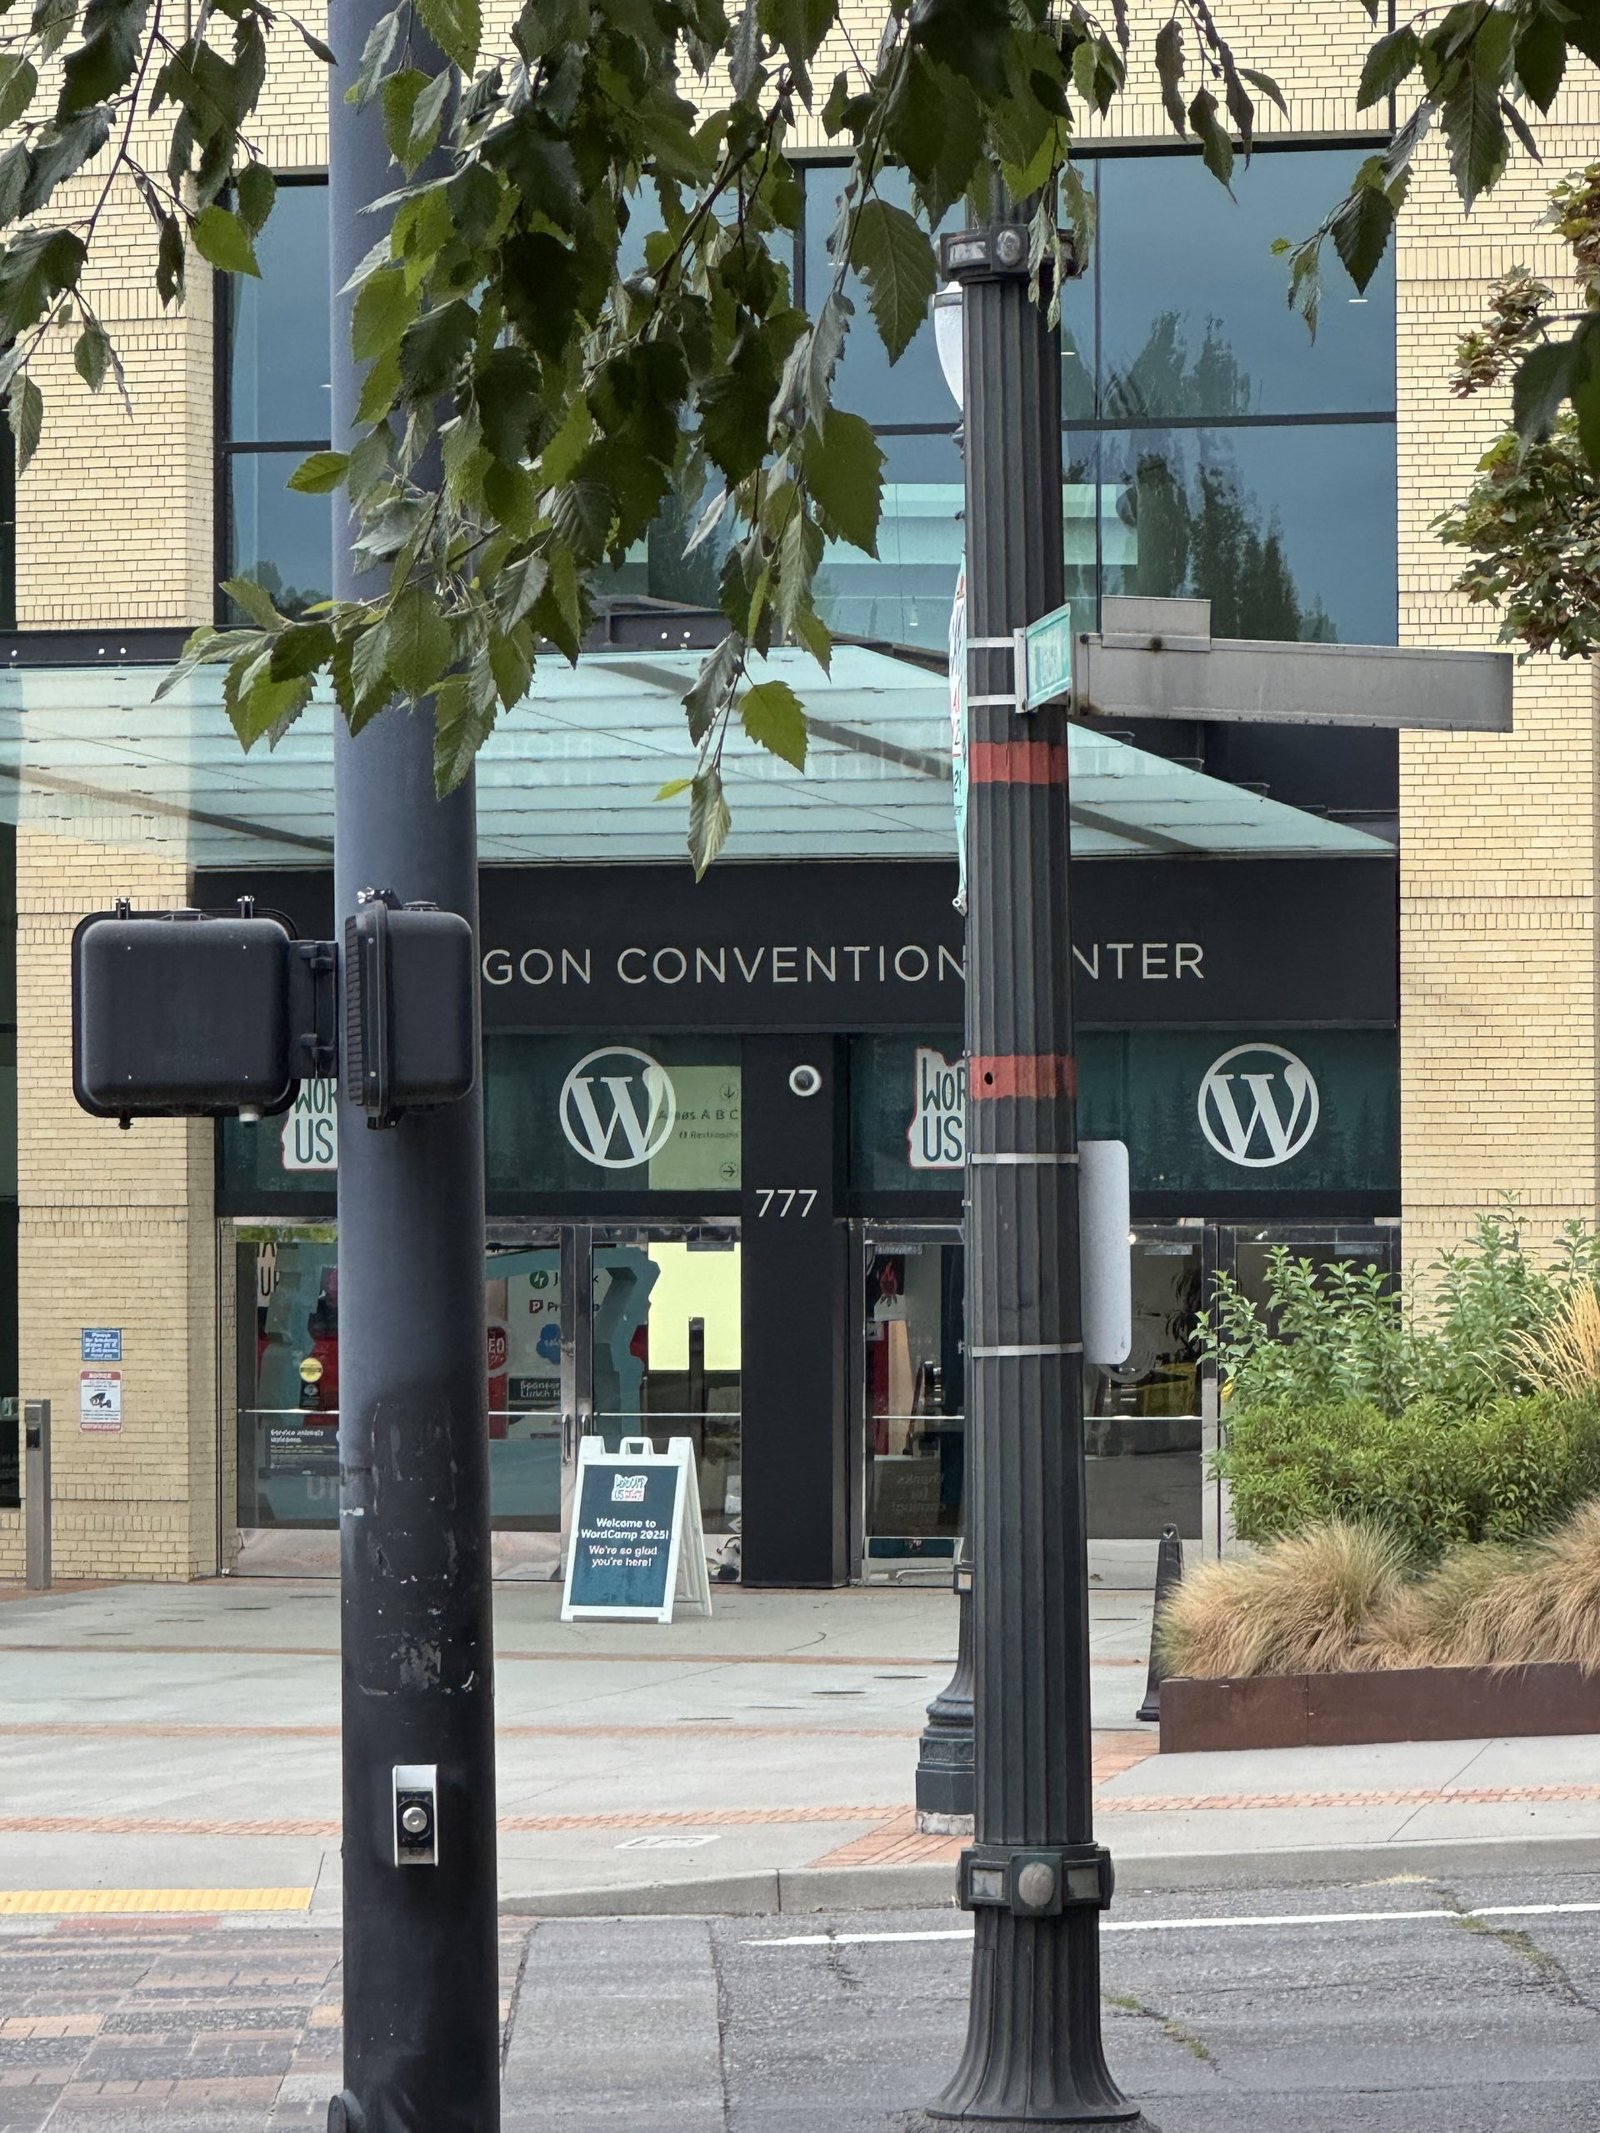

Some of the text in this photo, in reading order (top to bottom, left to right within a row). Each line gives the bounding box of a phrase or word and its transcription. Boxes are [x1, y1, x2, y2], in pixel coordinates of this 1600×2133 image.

[481, 942, 1205, 986] GON CONVENTION NTER
[295, 1118, 334, 1164] US
[922, 1115, 963, 1162] US
[756, 1189, 818, 1218] 777
[596, 1518, 656, 1528] Welcome to
[581, 1529, 669, 1541] WordCamp 2025!
[589, 1545, 658, 1557] We're so glad
[591, 1557, 652, 1568] you're here!
